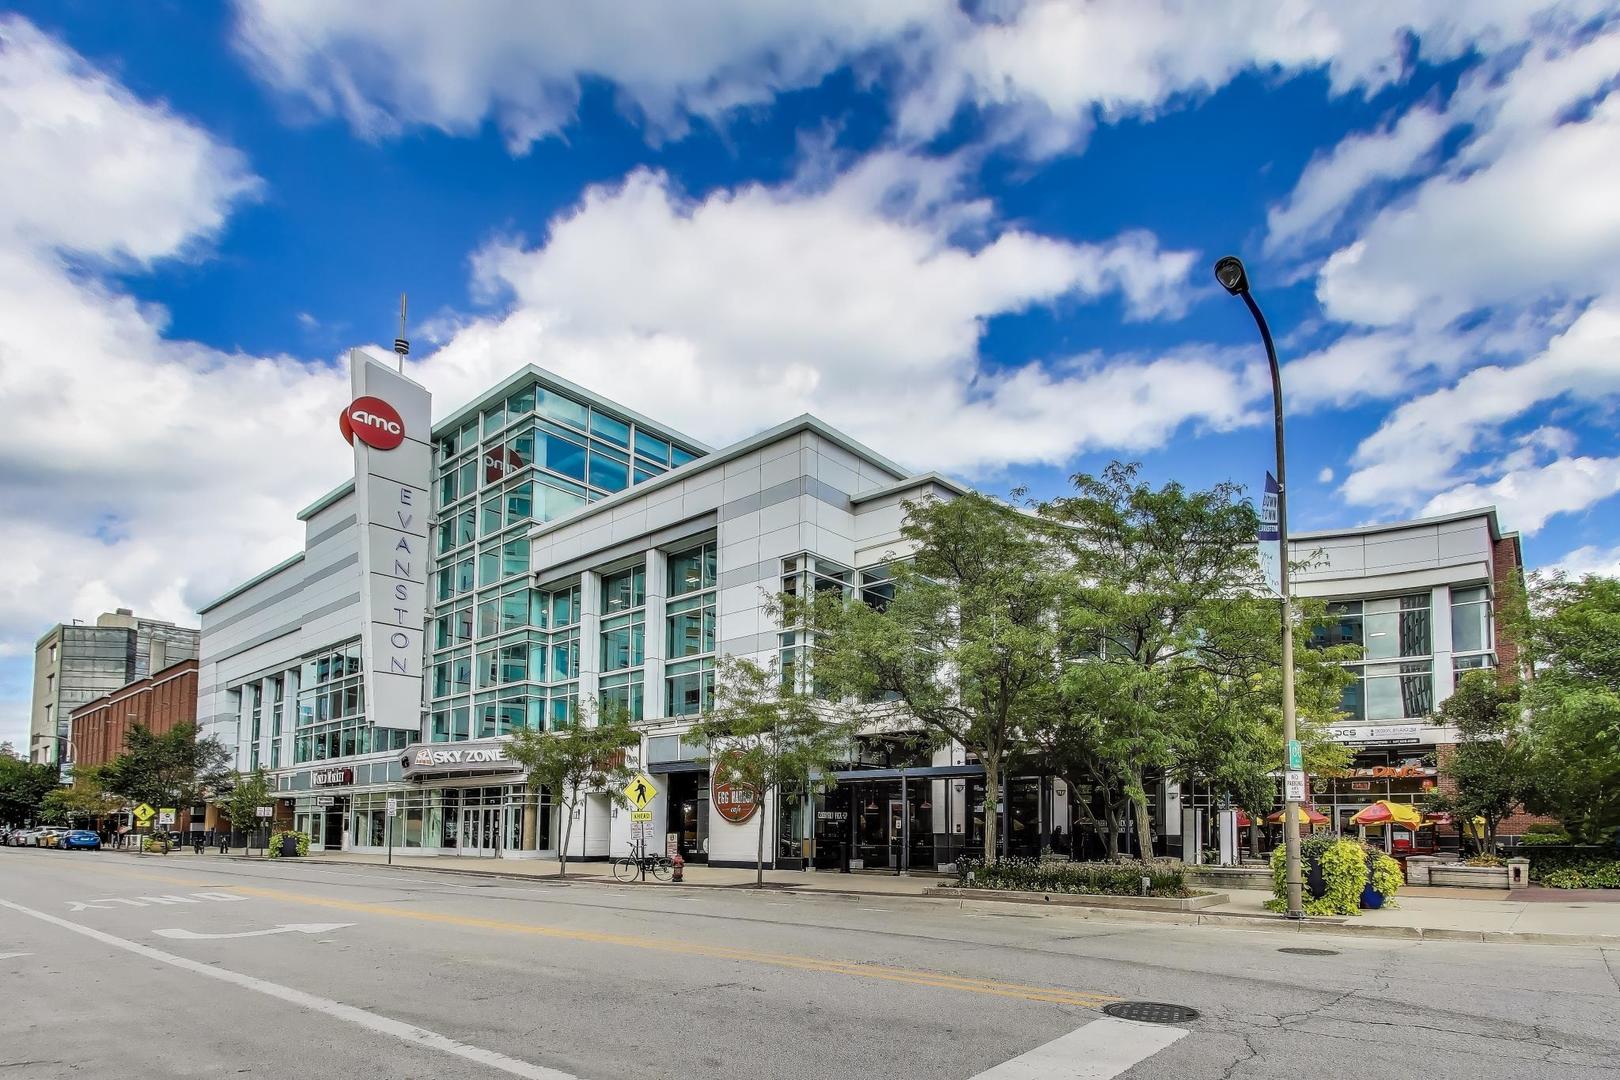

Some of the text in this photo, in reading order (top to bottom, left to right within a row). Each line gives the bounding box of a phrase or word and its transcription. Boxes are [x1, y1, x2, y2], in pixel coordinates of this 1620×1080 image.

[351, 410, 401, 435] amc
[391, 487, 413, 673] EVANSTON
[433, 750, 462, 764] SKY
[464, 749, 507, 762] ZONE
[633, 812, 651, 820] AHEAD
